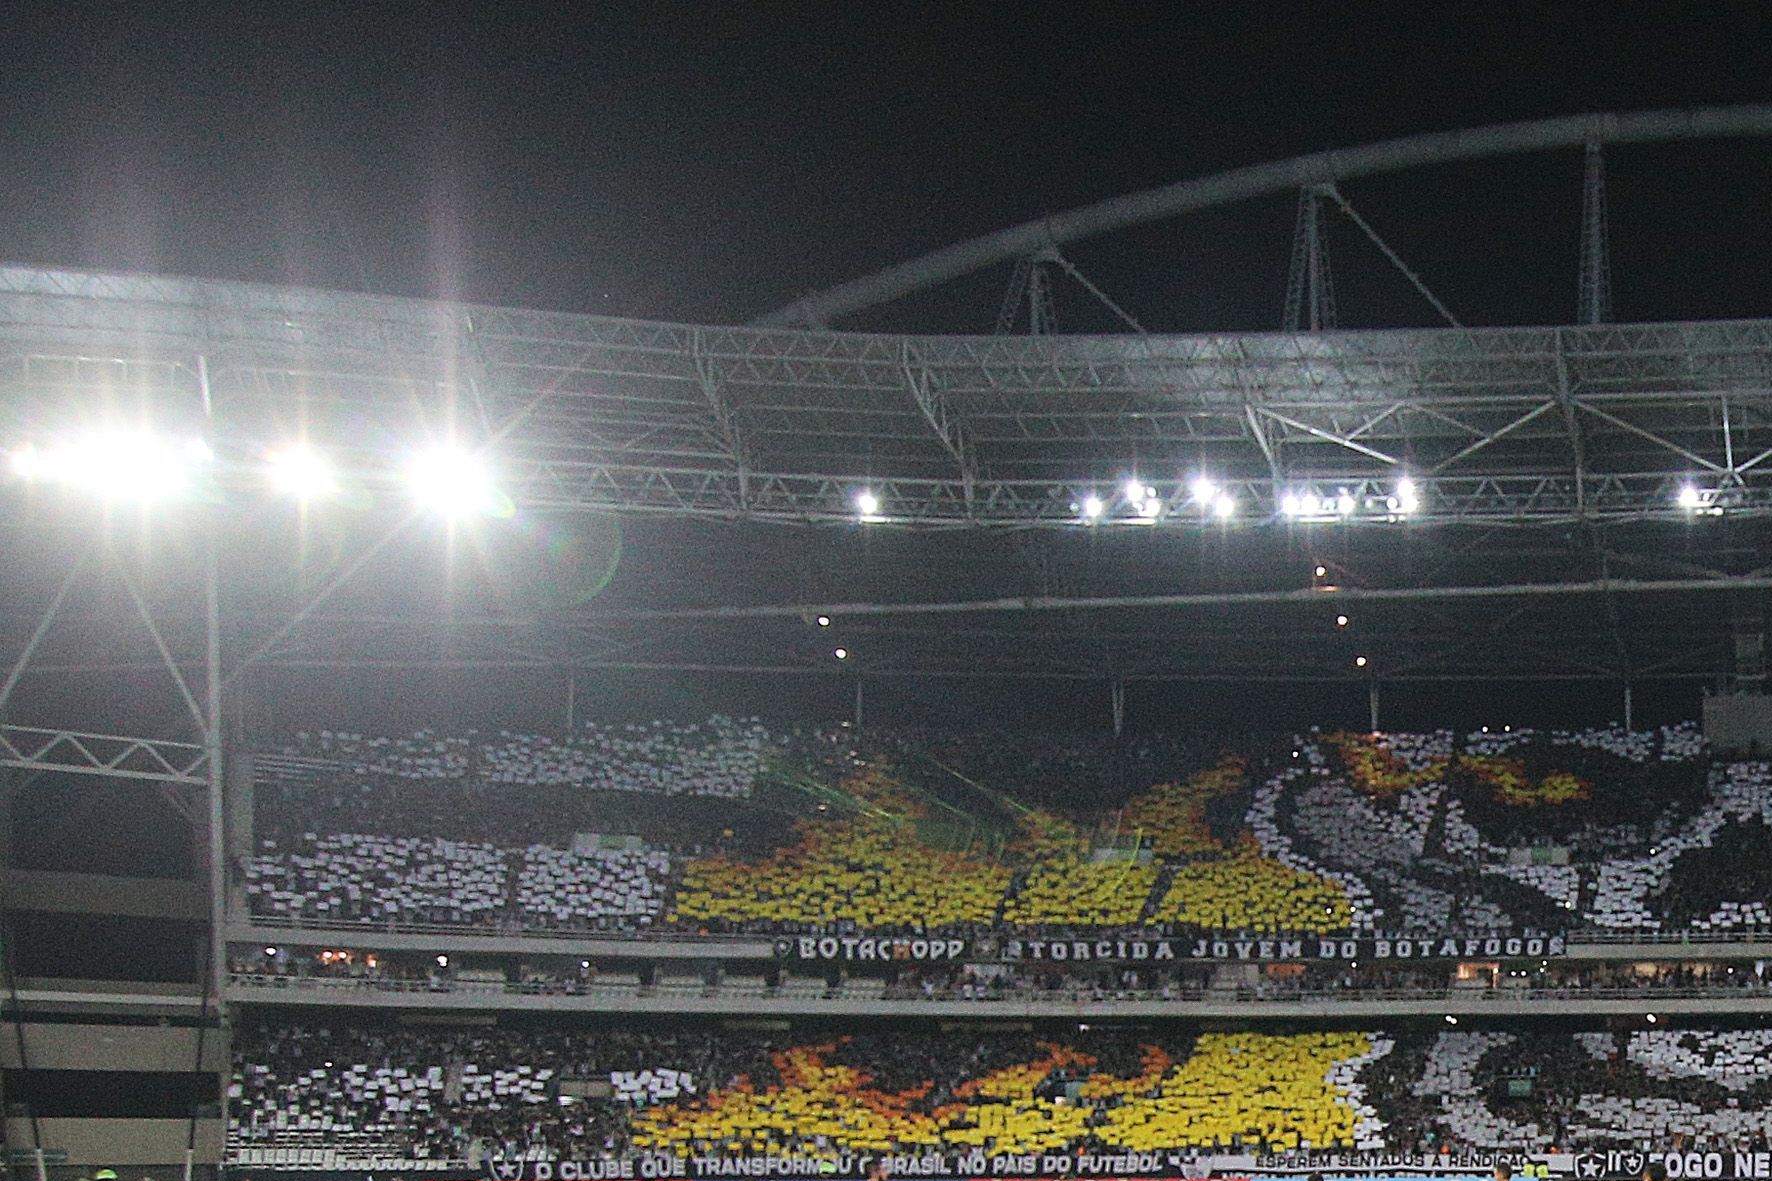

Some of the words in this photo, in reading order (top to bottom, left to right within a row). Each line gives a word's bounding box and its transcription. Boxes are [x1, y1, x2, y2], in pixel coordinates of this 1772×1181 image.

[1029, 941, 1174, 960] TORCIDA
[1192, 939, 1300, 958] JOVEM
[1320, 941, 1357, 958] DO
[1375, 939, 1543, 958] BOTAFOGO
[560, 1158, 634, 1180] CLUBE
[641, 1154, 687, 1178] QUE
[1043, 1155, 1072, 1174] DO
[1077, 1150, 1163, 1174] FUTEBOL
[1338, 1153, 1424, 1167] SENTADOS
